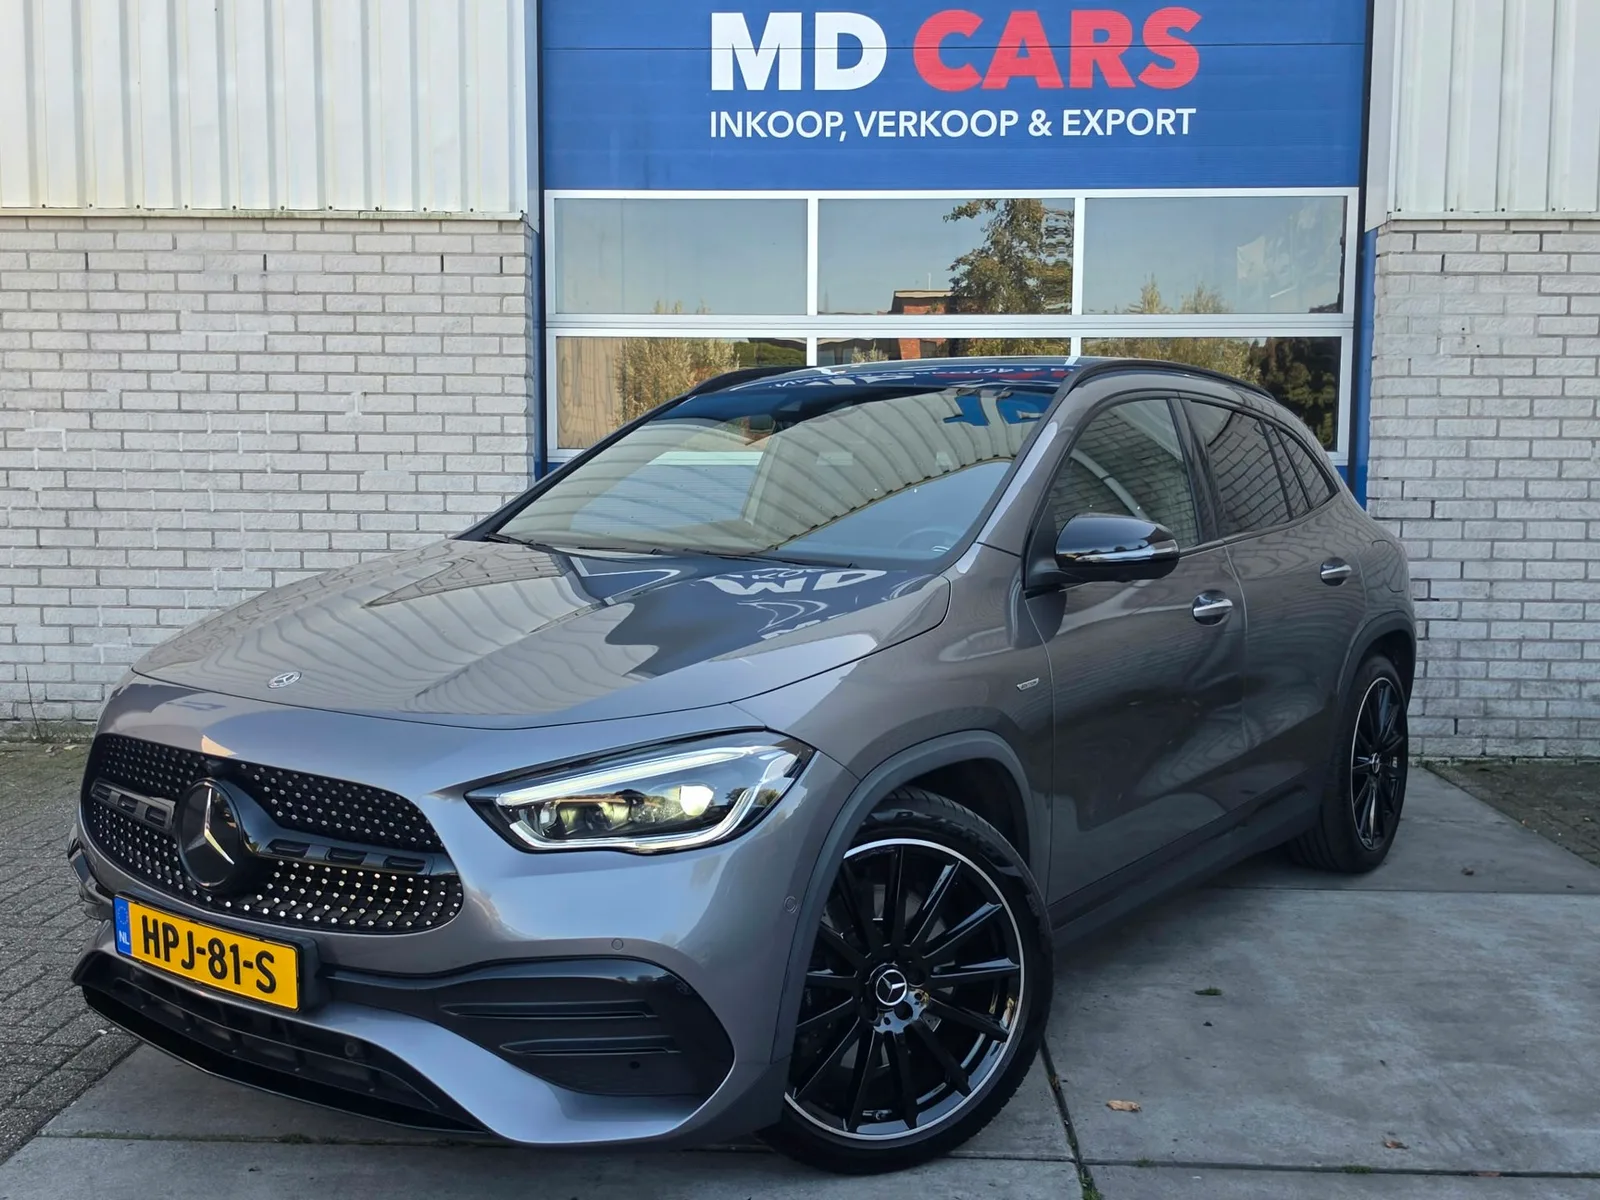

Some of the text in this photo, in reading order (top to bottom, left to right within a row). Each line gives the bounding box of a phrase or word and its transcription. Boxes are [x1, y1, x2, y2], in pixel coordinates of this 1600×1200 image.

[711, 7, 1202, 91] MD CARS
[711, 108, 1196, 141] INKOOP, VERKOOP & EXPORT
[118, 930, 130, 945] NL
[141, 914, 277, 994] HPJ-81-S
